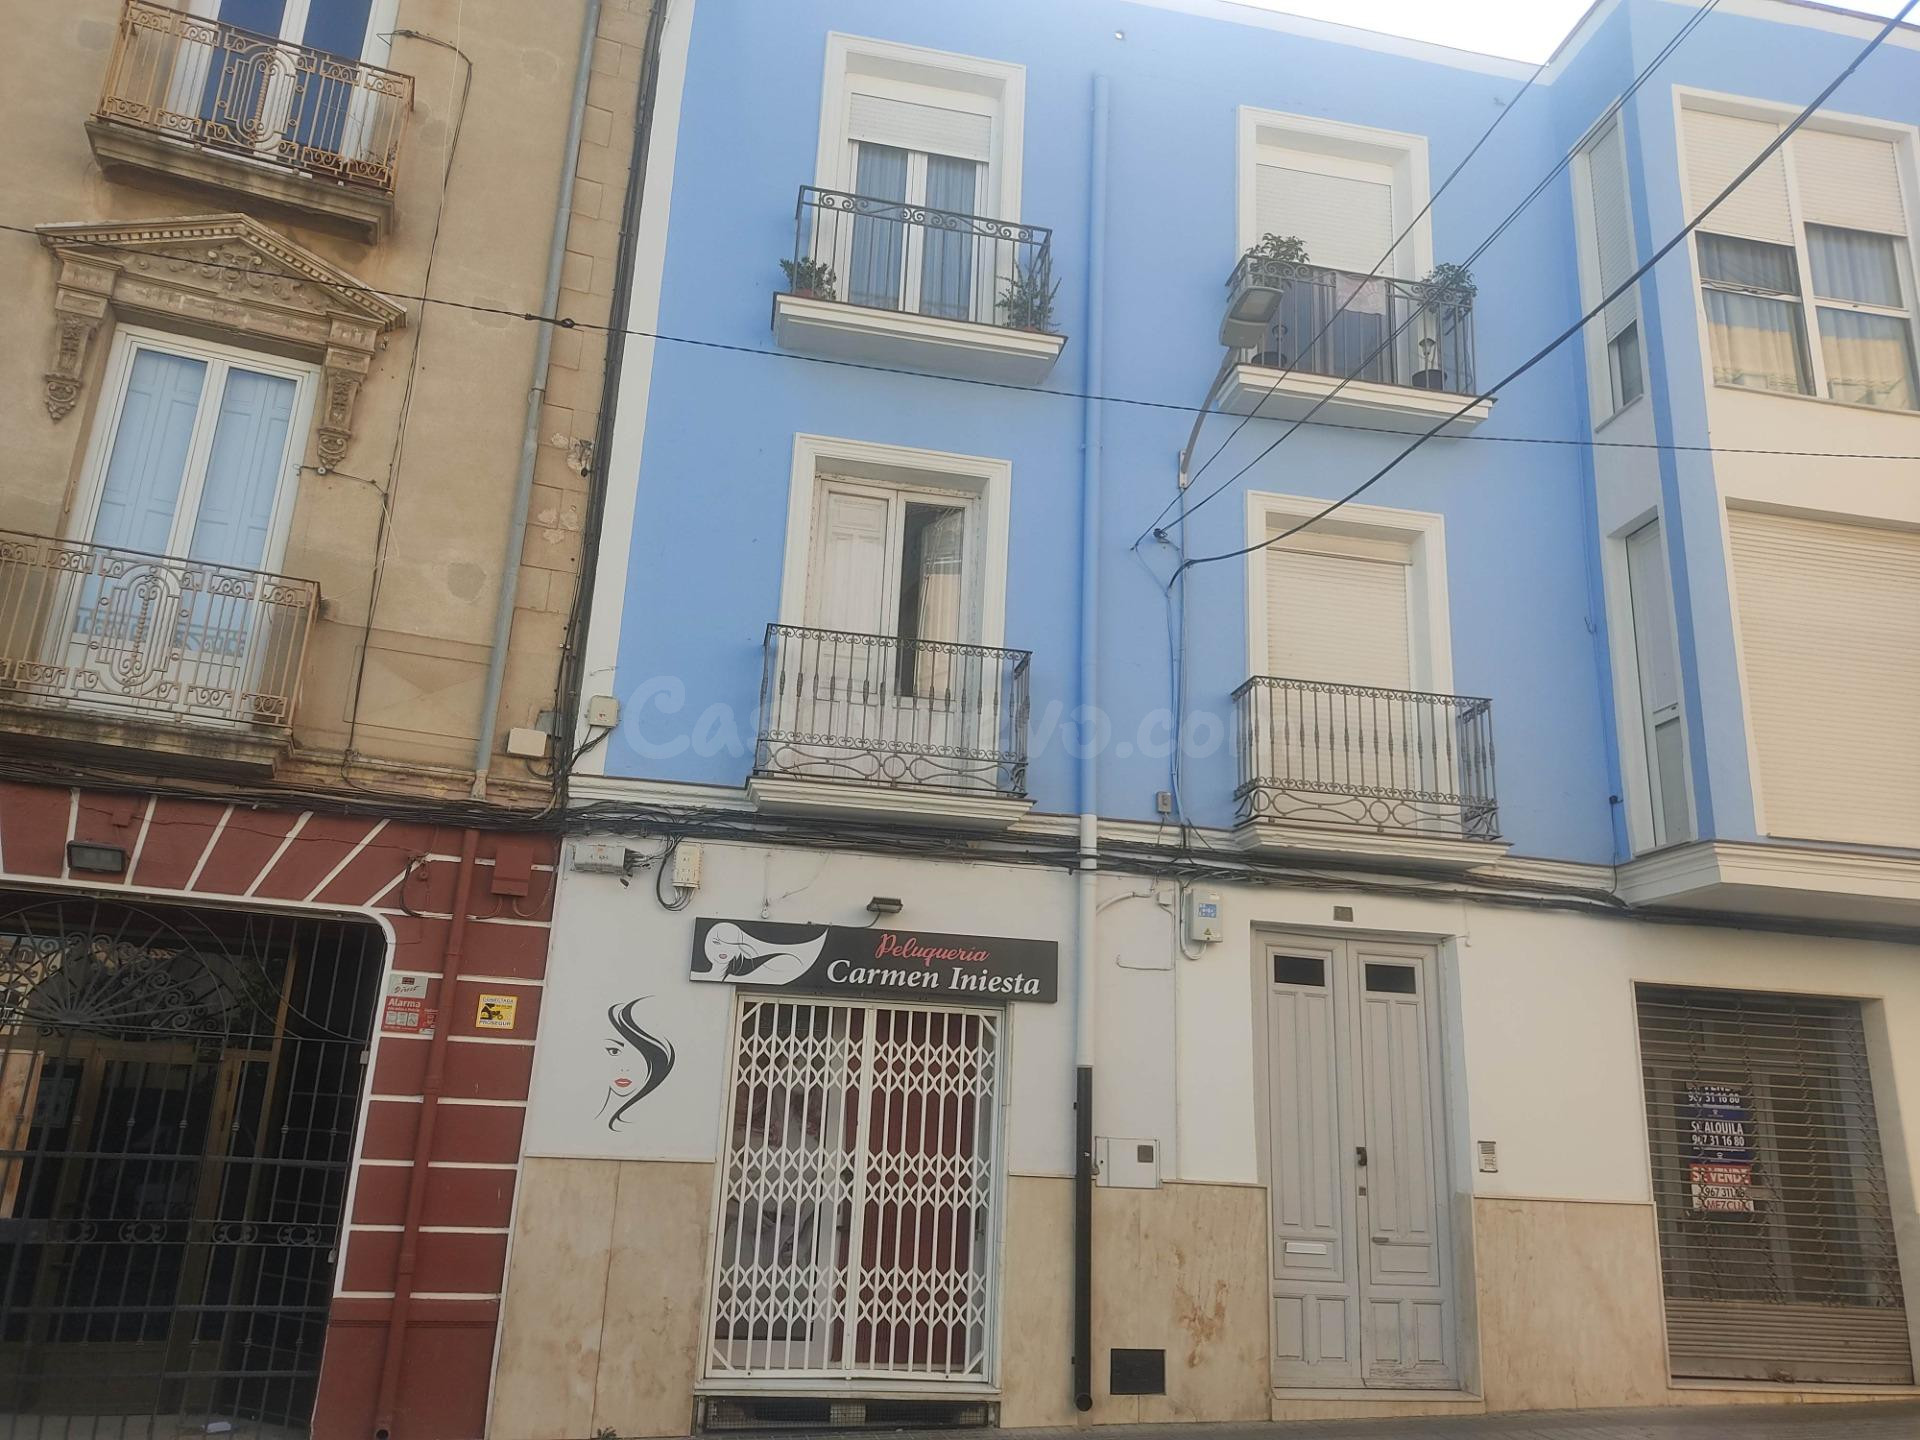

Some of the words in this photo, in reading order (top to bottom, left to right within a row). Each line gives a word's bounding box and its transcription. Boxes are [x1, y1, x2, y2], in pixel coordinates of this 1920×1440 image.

[826, 959, 940, 989] Carmen
[948, 966, 1041, 995] Iniesta
[388, 997, 421, 1008] Alarma
[1710, 1135, 1719, 1146] 31
[1722, 1136, 1732, 1146] 16
[1734, 1136, 1745, 1147] 80
[1705, 1187, 1720, 1197] 967
